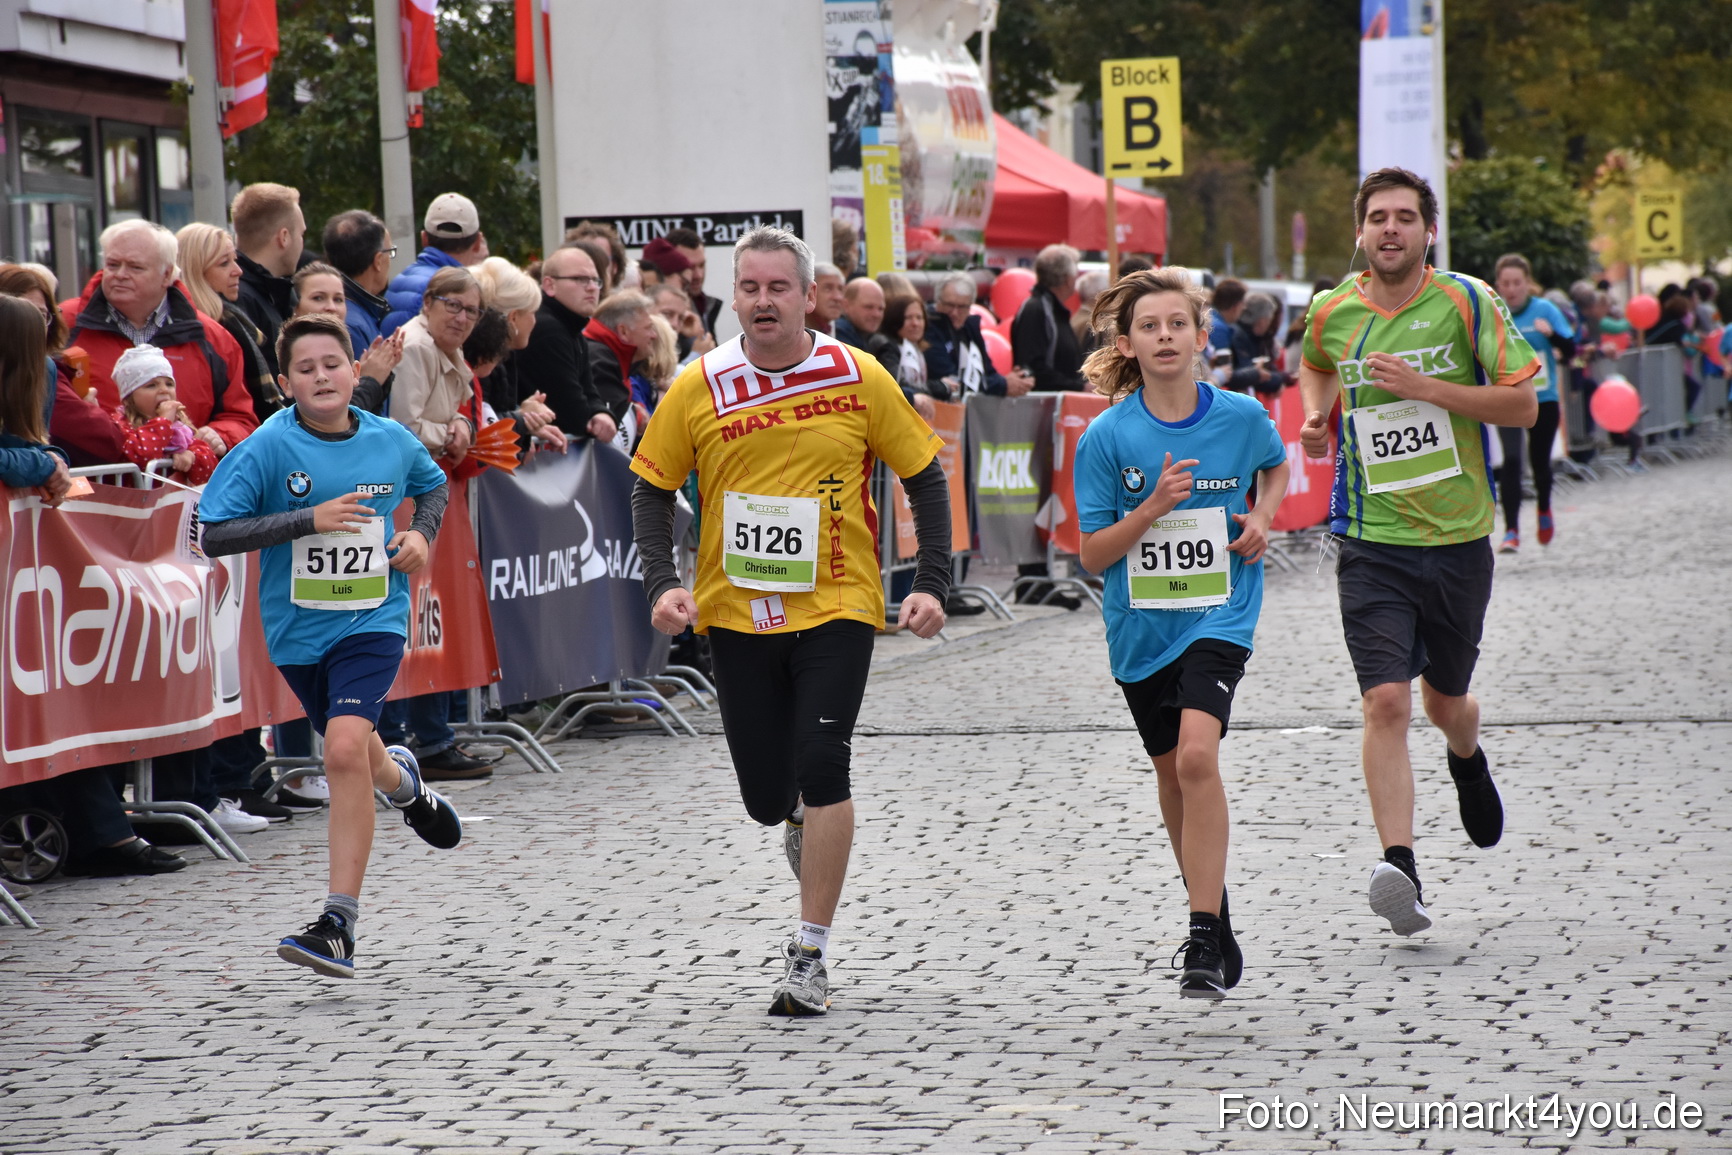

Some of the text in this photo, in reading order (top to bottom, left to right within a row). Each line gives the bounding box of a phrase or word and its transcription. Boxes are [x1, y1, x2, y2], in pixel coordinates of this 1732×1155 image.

[1111, 64, 1170, 87] Block
[1123, 95, 1162, 152] B
[1647, 209, 1669, 242] C
[719, 393, 868, 443] MAX BÖGL
[1386, 406, 1419, 421] BOCK
[1371, 421, 1439, 458] 5234
[355, 483, 394, 496] BOCK
[1195, 477, 1240, 490] BOCK
[755, 504, 789, 514] BOCK
[1162, 519, 1197, 529] BOCK
[735, 522, 802, 556] 5126
[307, 546, 374, 574] 5127
[1141, 539, 1214, 571] 5199
[745, 561, 788, 575] Christian
[332, 584, 353, 595] Luis
[1169, 581, 1189, 592] Mia
